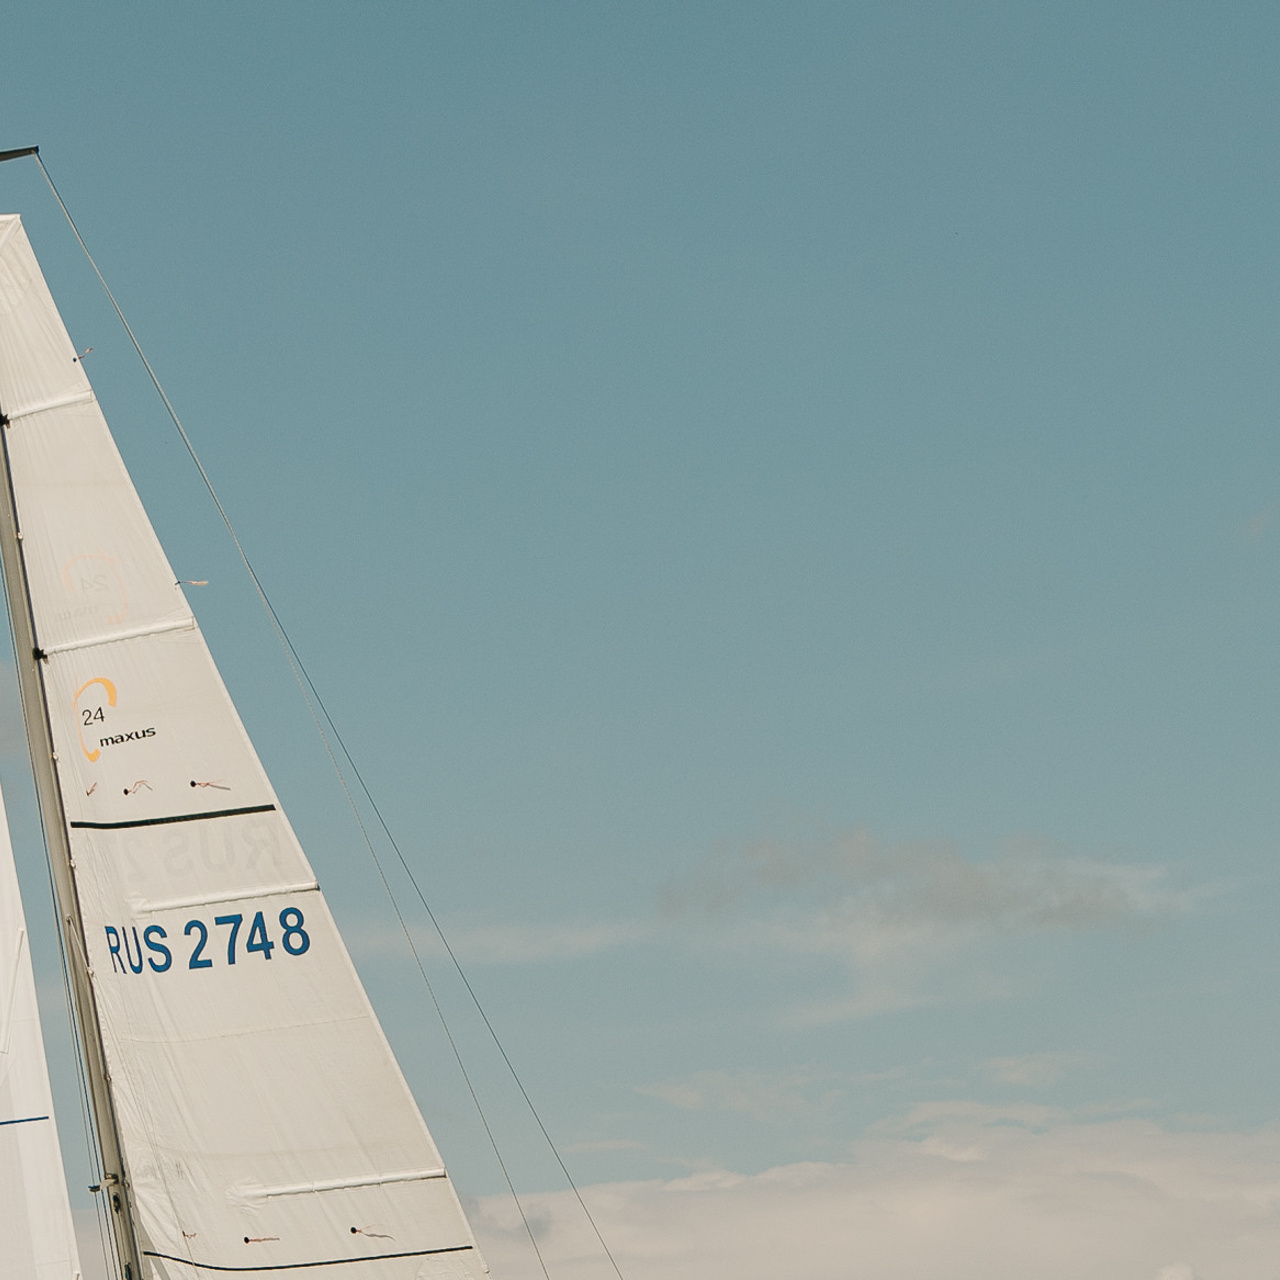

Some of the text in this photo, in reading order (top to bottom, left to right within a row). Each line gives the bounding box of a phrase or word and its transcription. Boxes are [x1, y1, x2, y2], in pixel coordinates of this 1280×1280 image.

[82, 706, 106, 727] 24
[99, 727, 157, 748] maxus
[105, 907, 311, 974] RUS 2748
